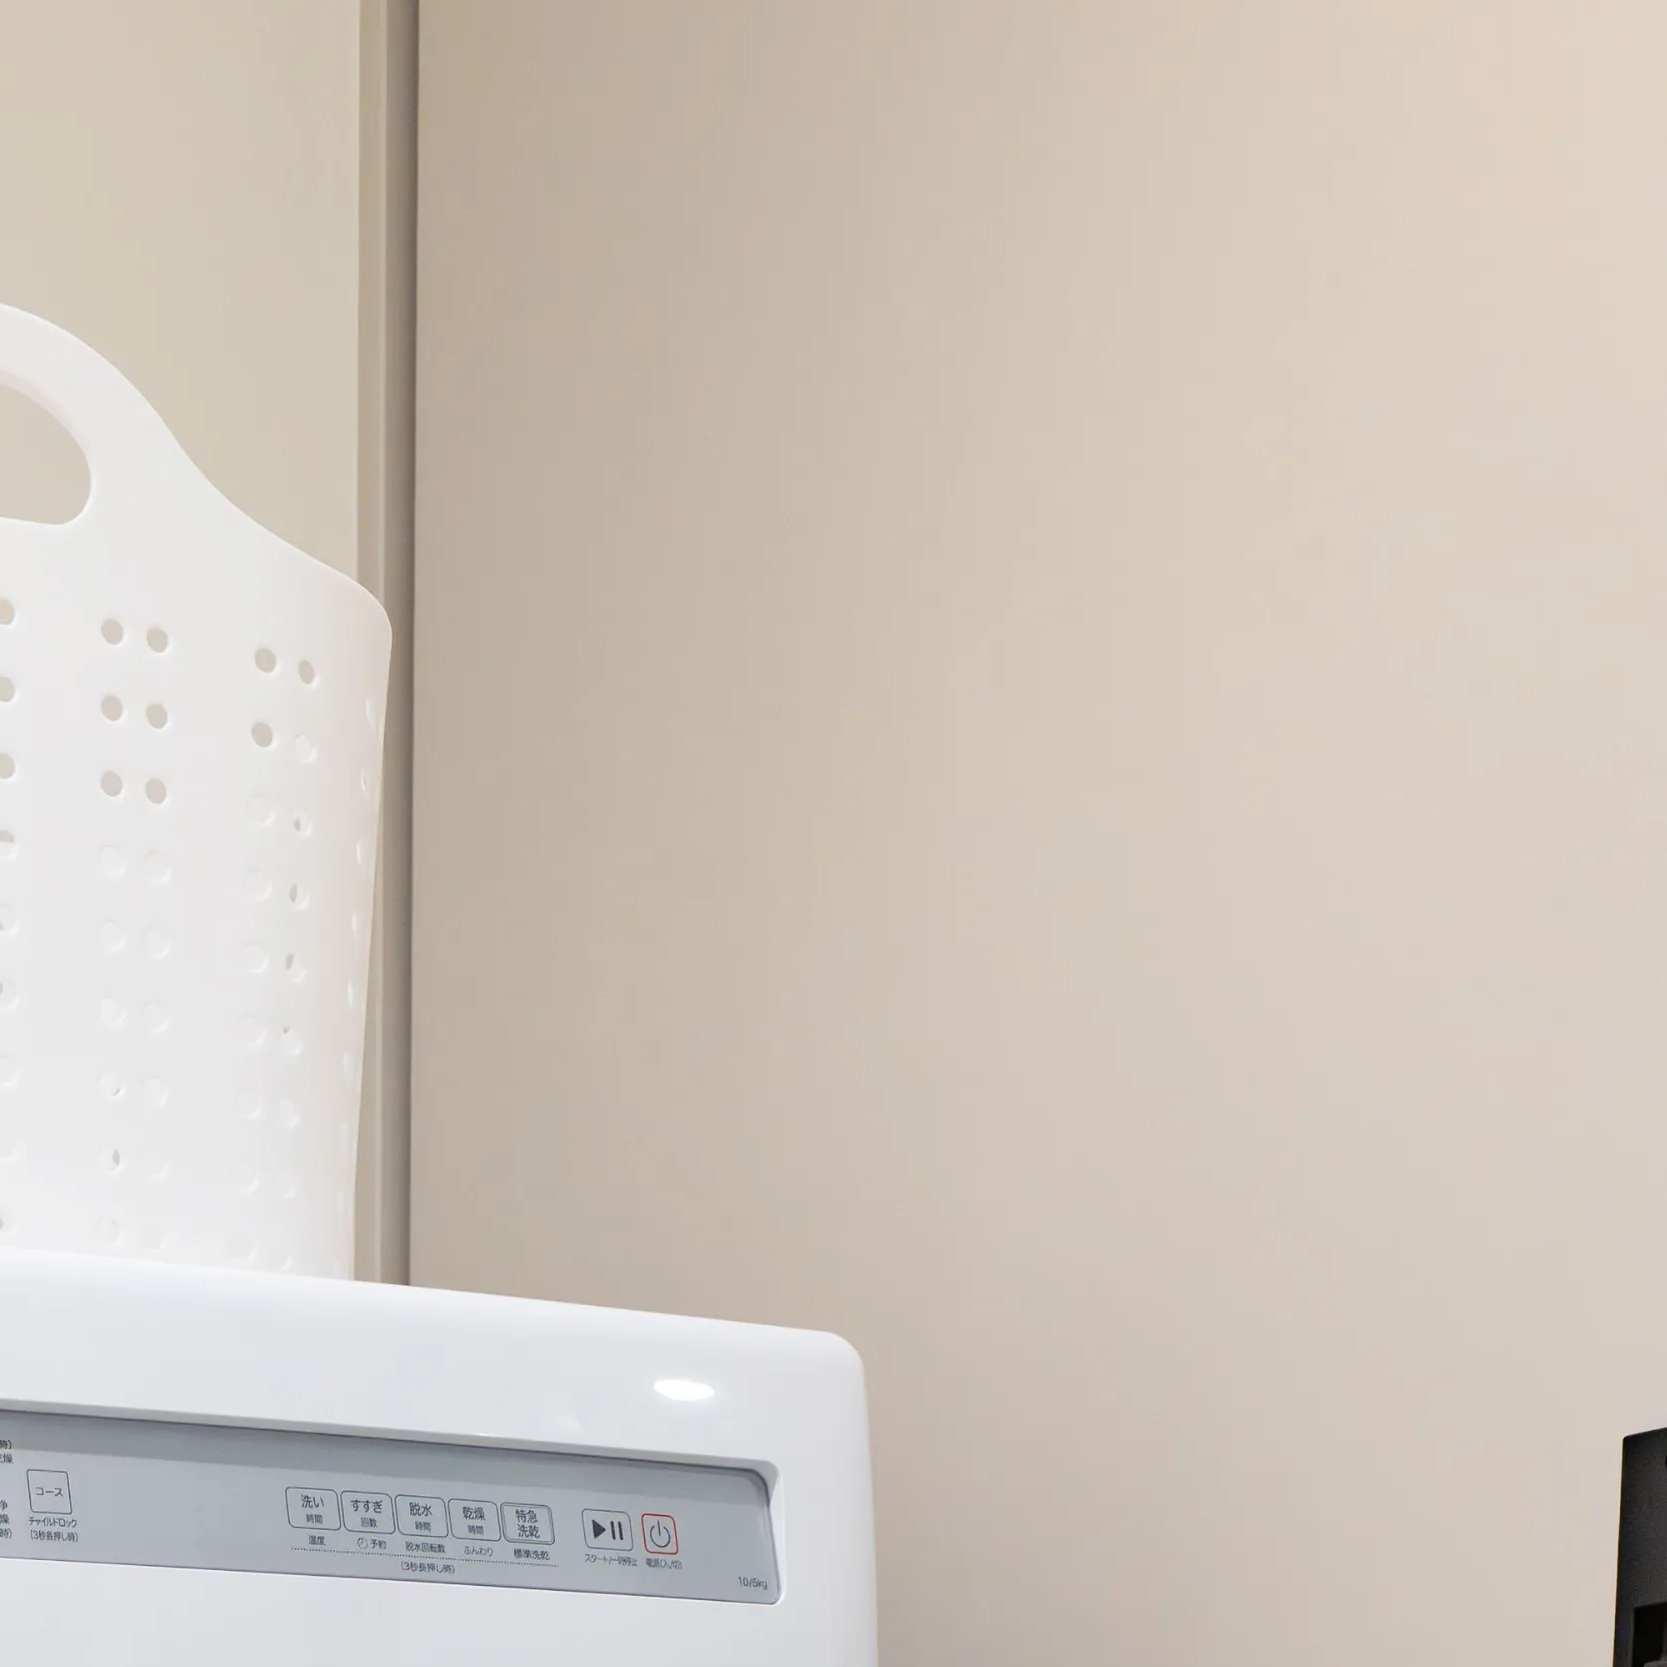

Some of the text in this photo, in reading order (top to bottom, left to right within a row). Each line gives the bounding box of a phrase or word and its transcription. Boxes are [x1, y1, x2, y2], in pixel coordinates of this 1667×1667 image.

[35, 1486, 64, 1497] コース
[301, 1494, 325, 1508] 洗い
[350, 1499, 383, 1514] すすぎ
[409, 1502, 433, 1517] 脱水
[462, 1506, 486, 1521] 乾燥
[515, 1509, 538, 1523] 特急
[28, 1516, 78, 1529] チャイルドロック
[517, 1523, 540, 1538] 洗乾
